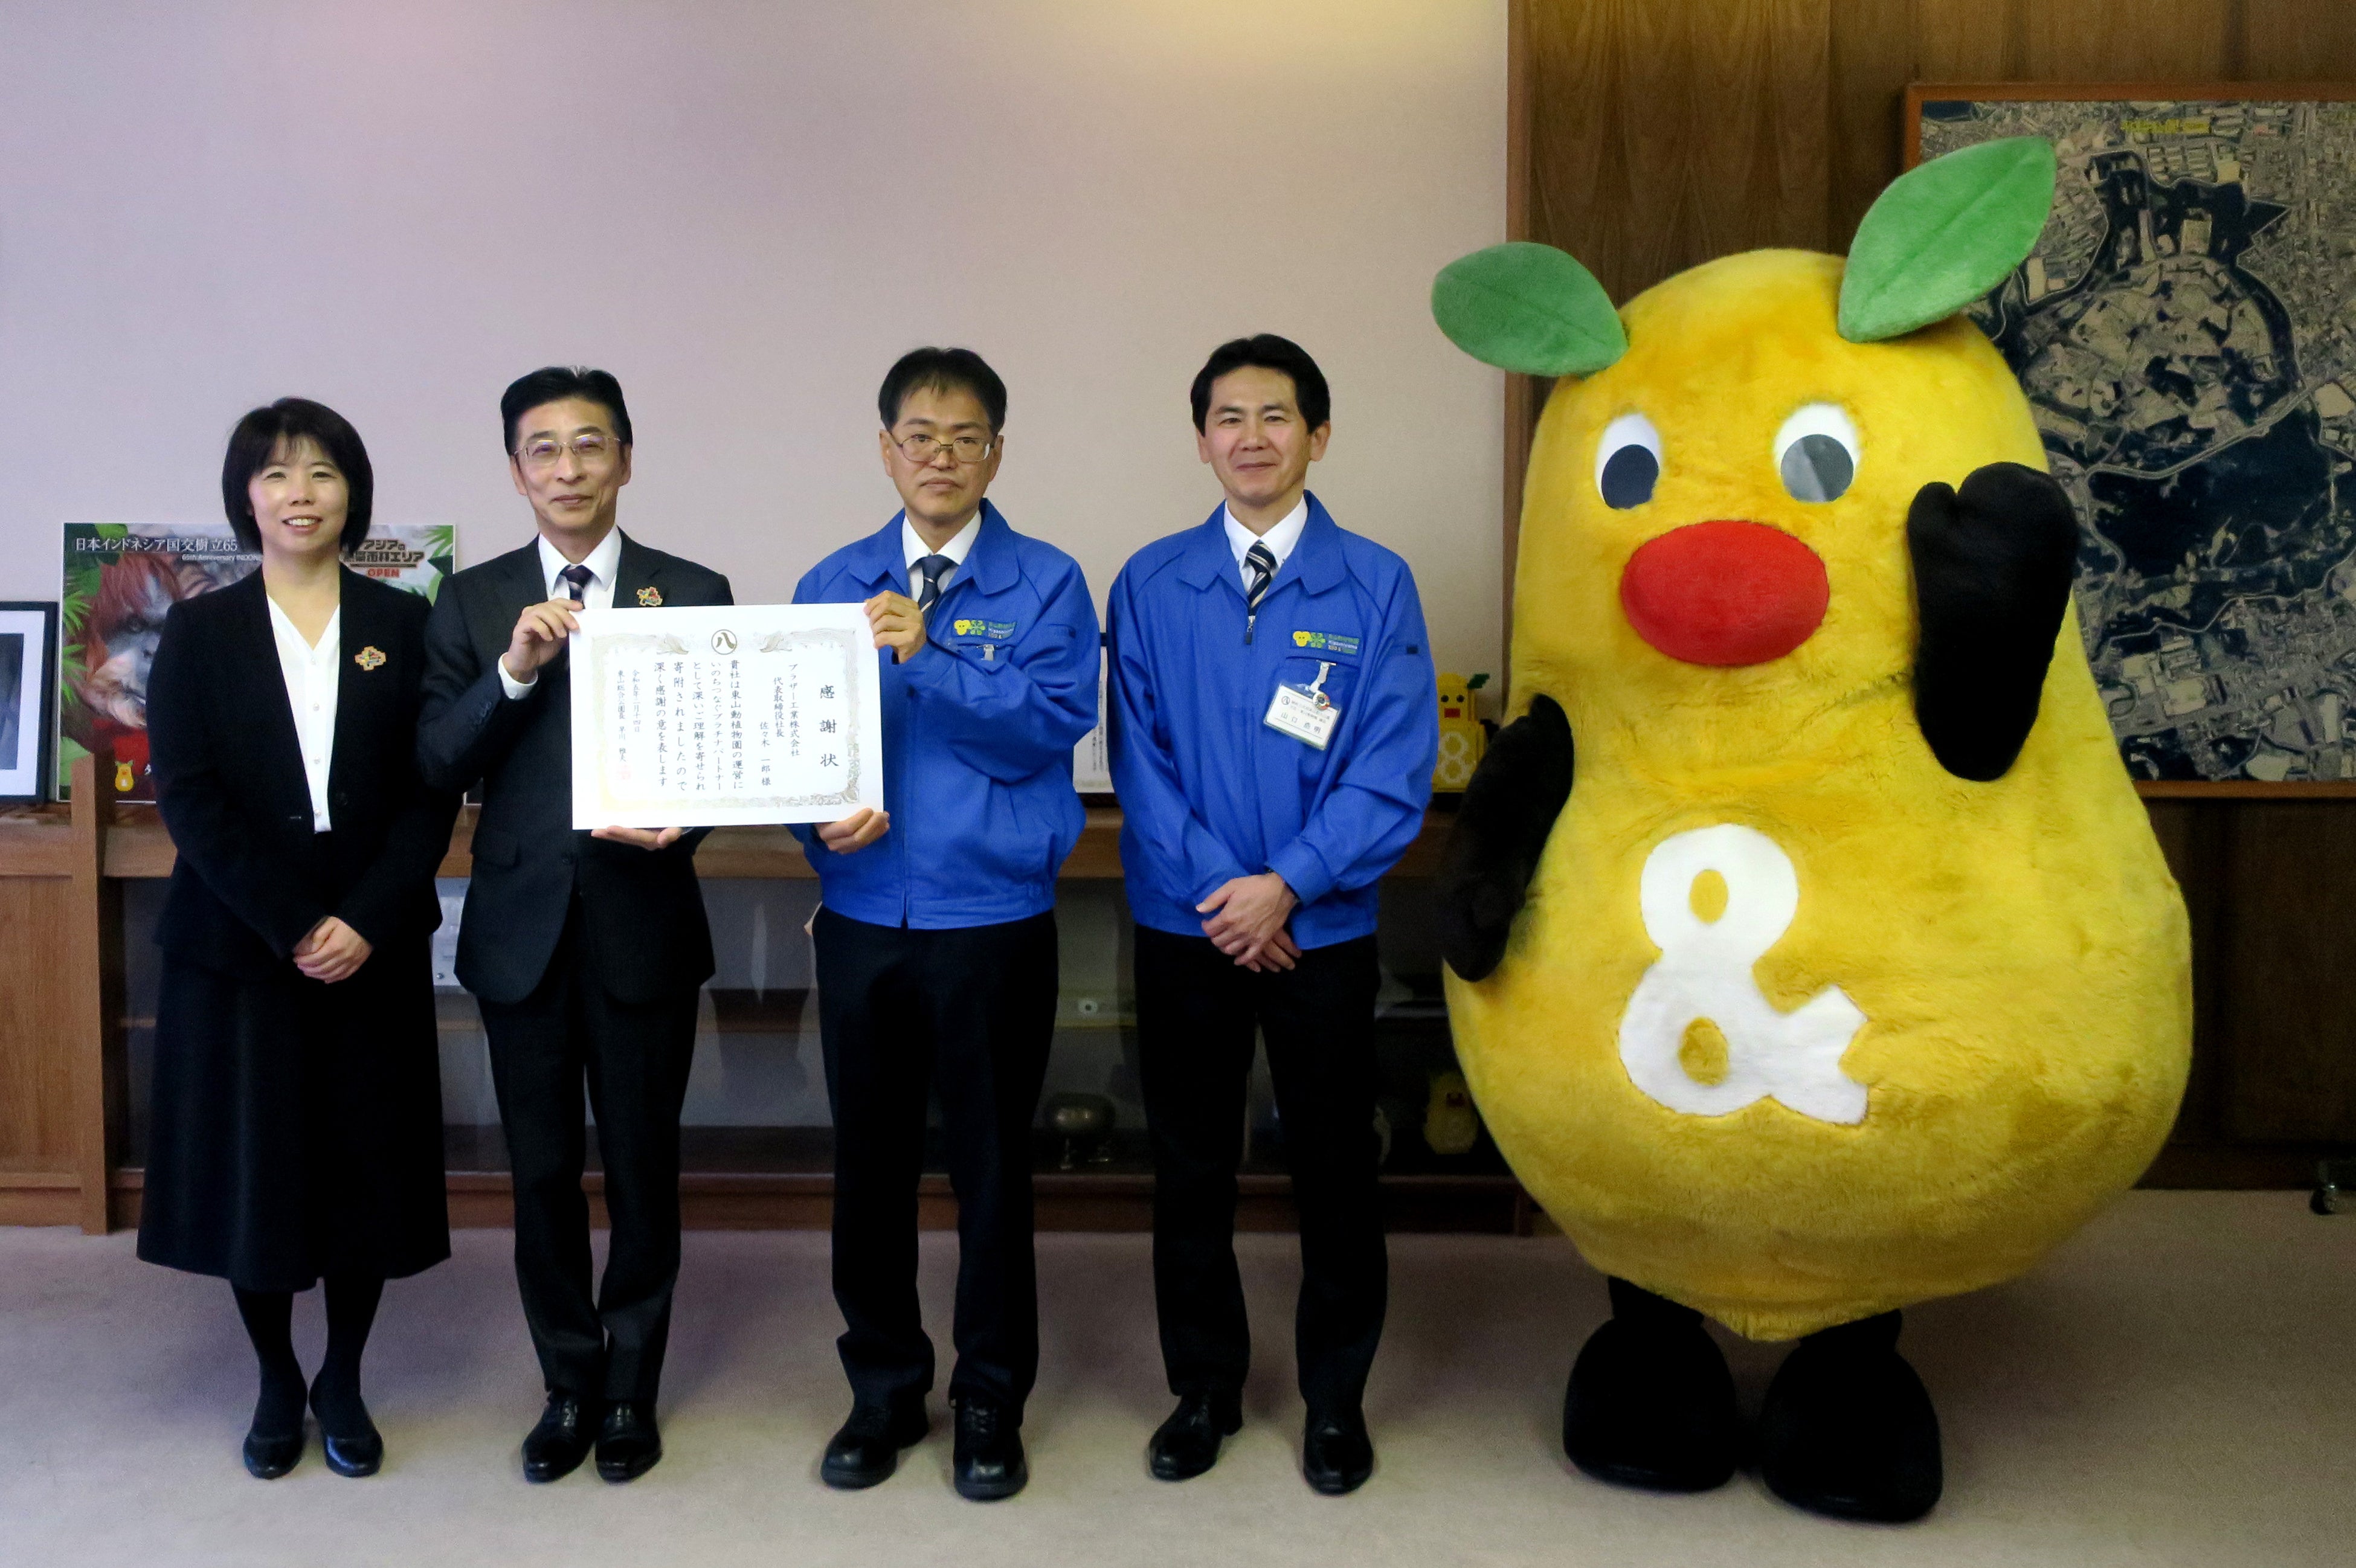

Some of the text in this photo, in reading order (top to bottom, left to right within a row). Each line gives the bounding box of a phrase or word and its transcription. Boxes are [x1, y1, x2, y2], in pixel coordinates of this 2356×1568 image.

[76, 537, 238, 552] 日本インドネシア国交樹立65
[368, 569, 399, 577] OPEN
[654, 662, 668, 786] 深く感謝の意を表します
[674, 661, 687, 791] 寄附されましたので
[819, 684, 839, 768] 感謝状
